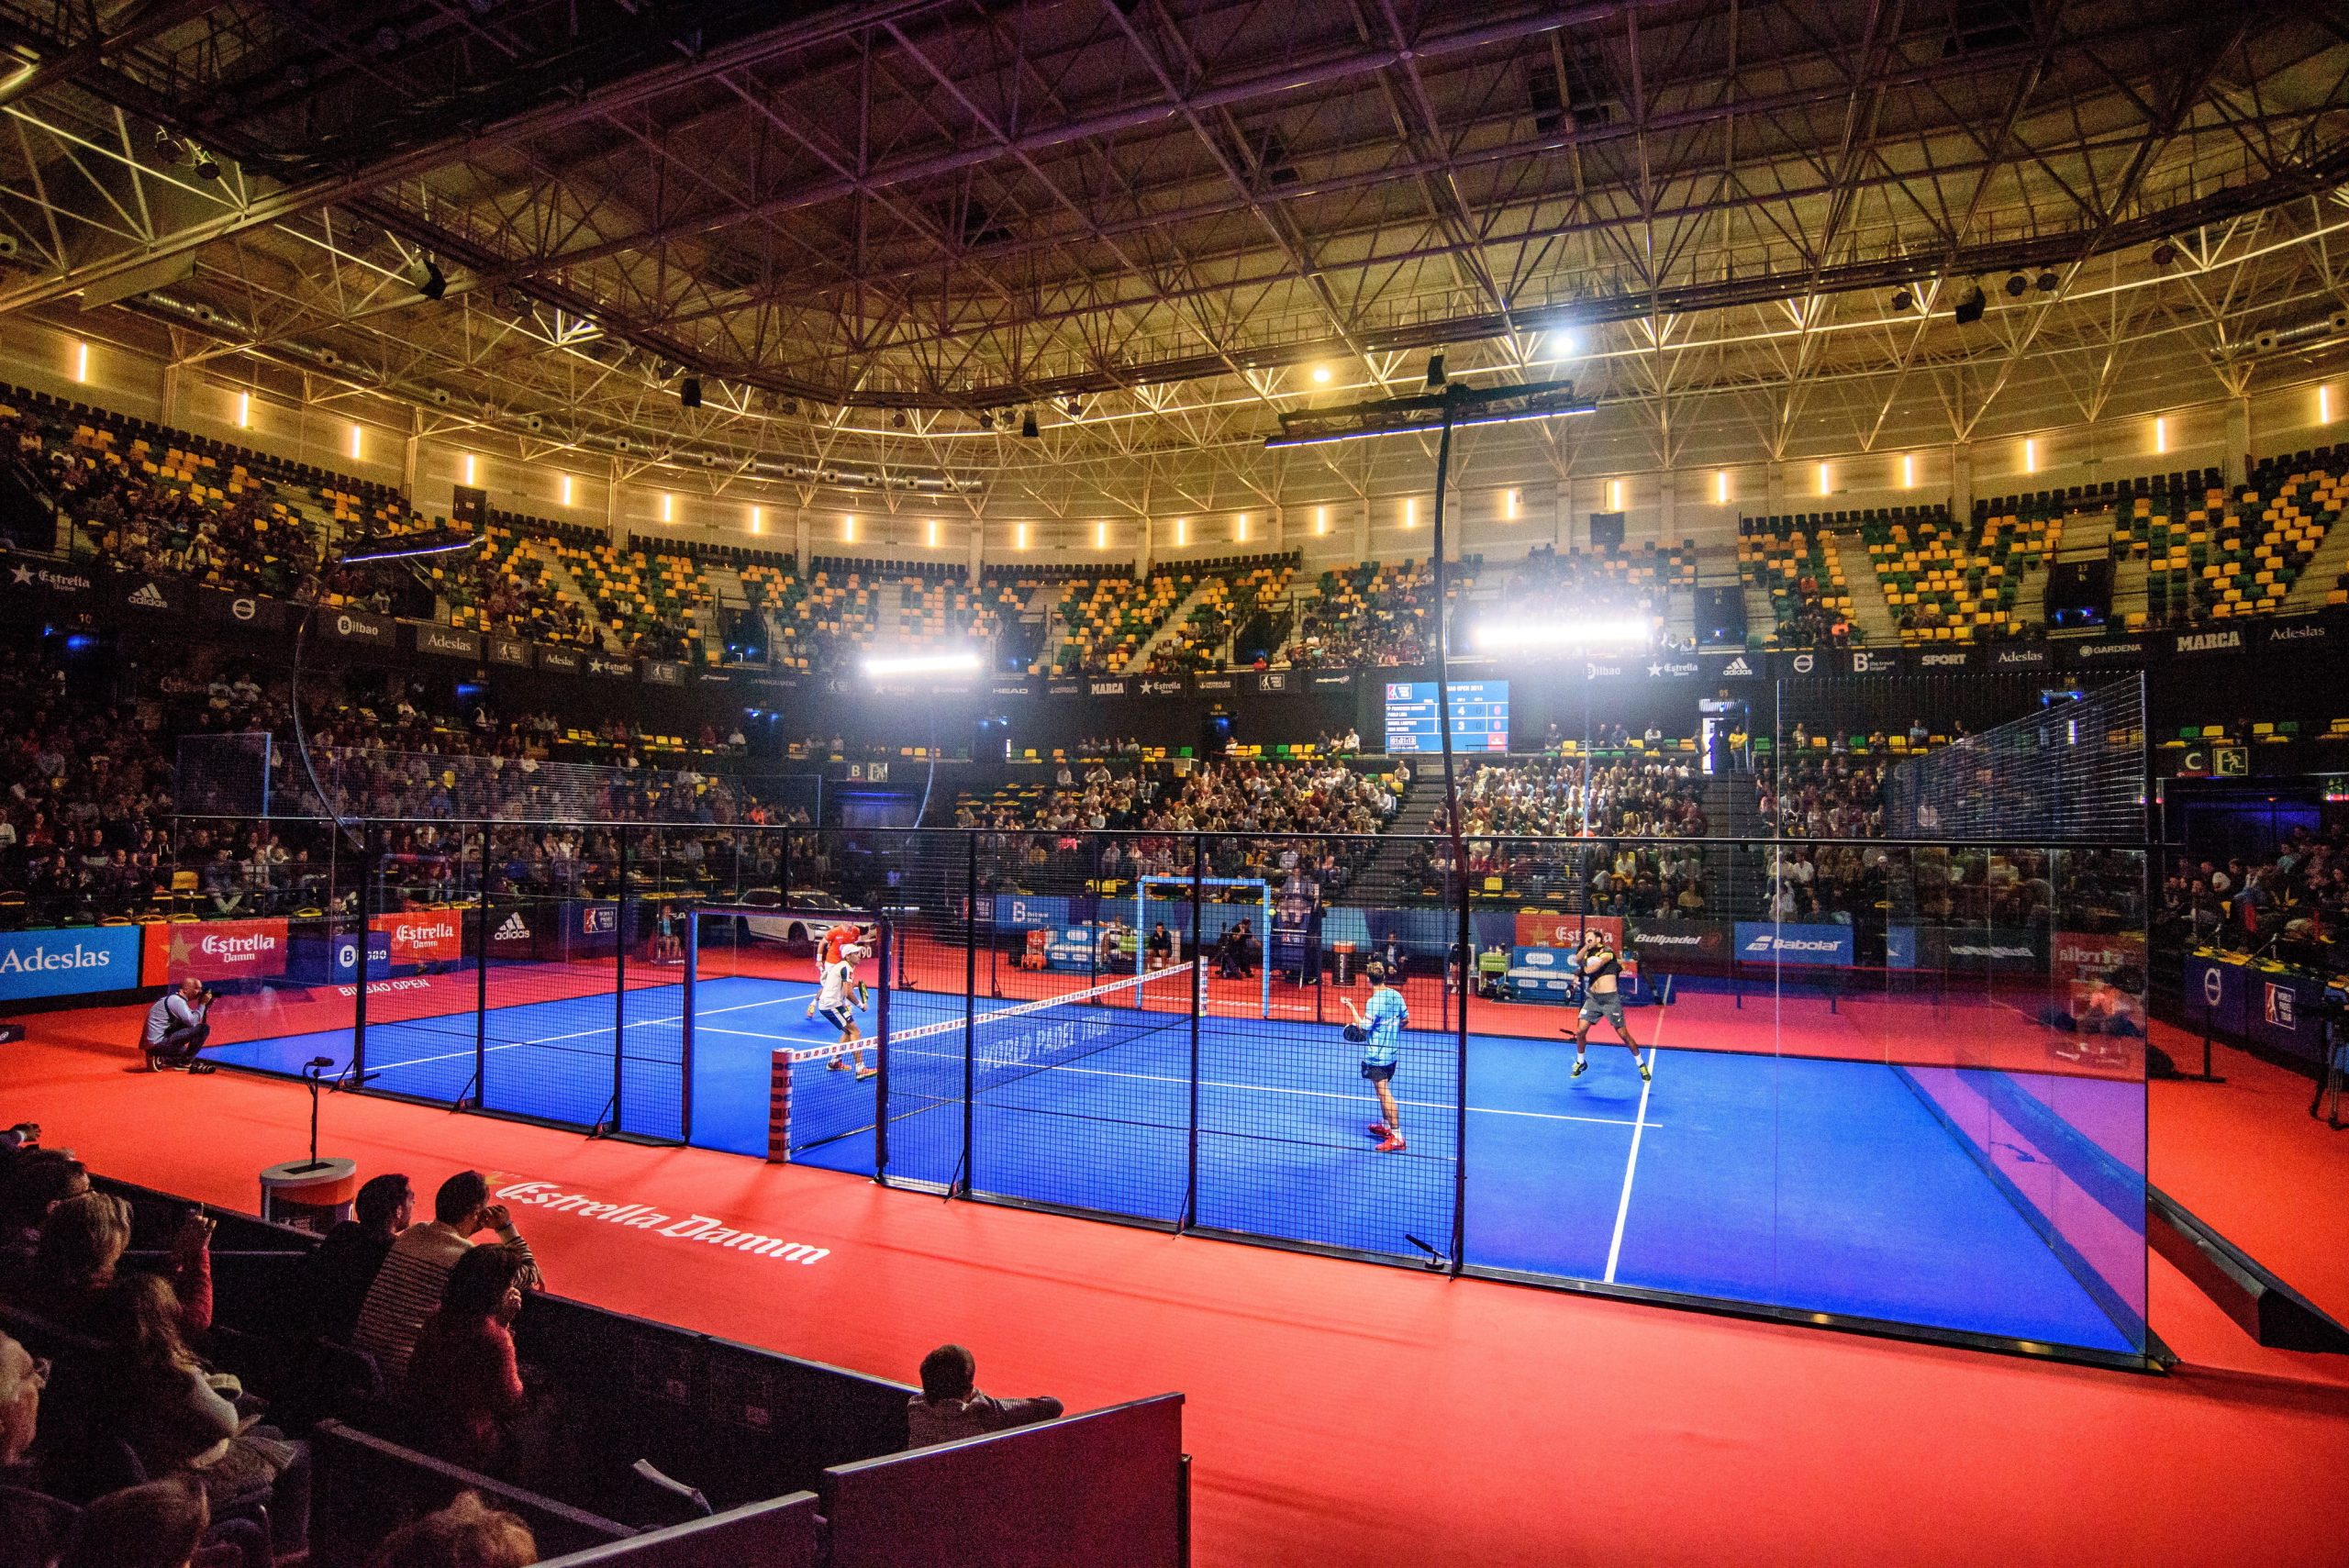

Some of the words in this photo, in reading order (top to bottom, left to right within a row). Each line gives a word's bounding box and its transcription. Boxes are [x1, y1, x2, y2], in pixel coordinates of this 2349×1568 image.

[39, 569, 90, 588] Estrella
[128, 595, 167, 608] adidas
[339, 616, 379, 636] Bilbao
[2270, 625, 2325, 640] Adeslas
[429, 633, 472, 651] Adeslas
[2176, 630, 2241, 652] MARCA
[2094, 643, 2142, 654] GARDENA
[546, 653, 574, 667] Adeslas
[1921, 653, 1966, 665] SPORT
[1998, 651, 2043, 662] Adeslas
[604, 662, 632, 673] Estrella
[1587, 662, 1621, 680] Bilbao
[1664, 663, 1698, 673] Estrella
[1091, 683, 1124, 695] MARCA
[1153, 681, 1181, 691] Estrella
[1457, 706, 1465, 716] 4
[1457, 721, 1465, 731] 3
[2185, 752, 2202, 770] C
[852, 764, 861, 777] B
[396, 923, 454, 942] Estrella
[495, 929, 530, 940] adidas
[1555, 927, 1613, 943] Esta
[202, 933, 275, 954] Estrella
[413, 939, 439, 949] Damm
[1634, 934, 1701, 945] Bullpadel
[1773, 939, 1842, 951] Babolat
[0, 944, 110, 973] Adeslas
[224, 951, 256, 963] Damm
[392, 979, 430, 990] OPEN
[978, 1034, 1030, 1075] WORLD
[1036, 1021, 1074, 1057] PADEL
[495, 1181, 671, 1229] Estrella
[654, 1213, 831, 1265] Damm
